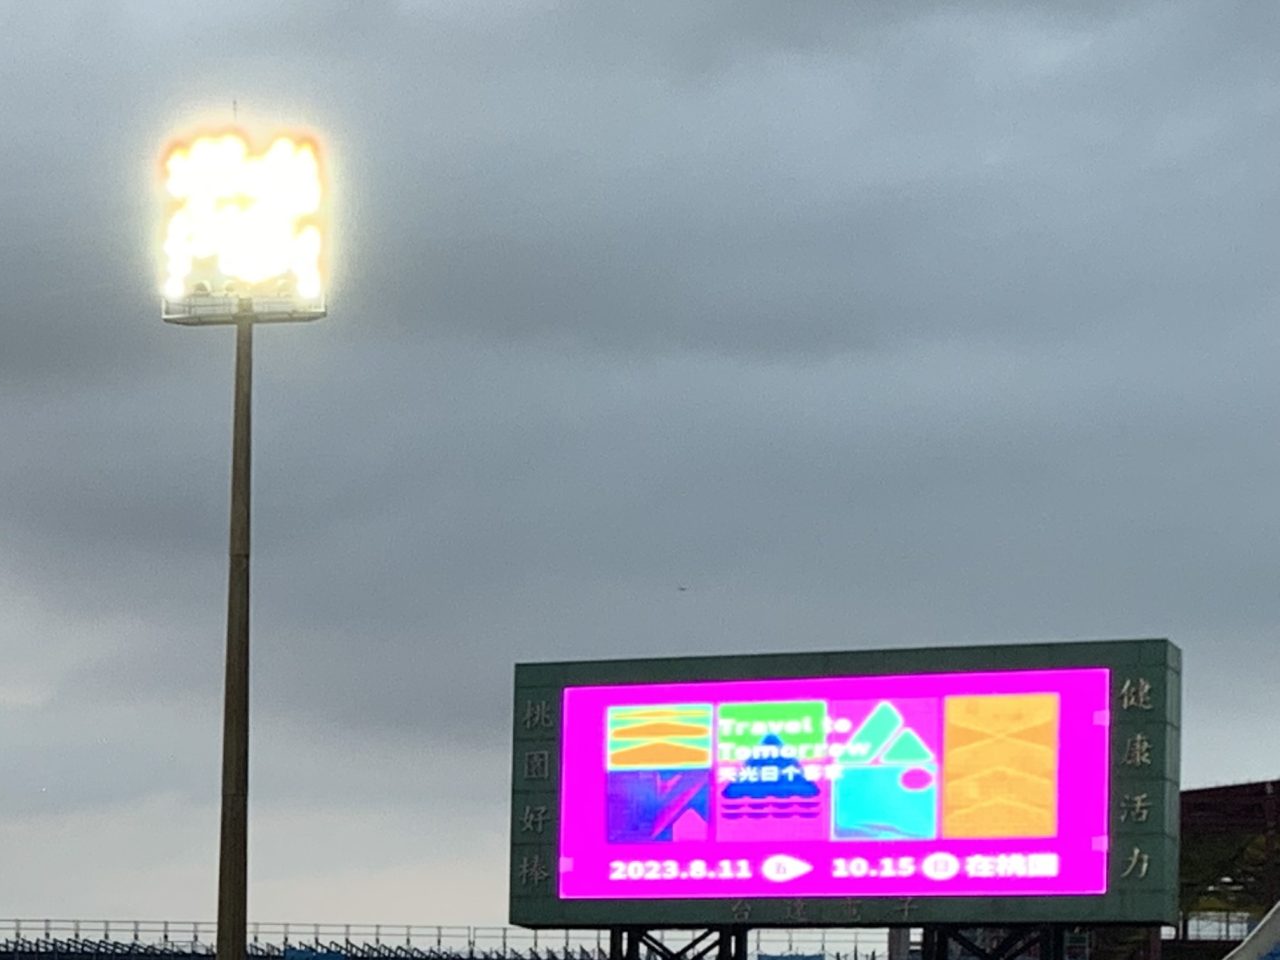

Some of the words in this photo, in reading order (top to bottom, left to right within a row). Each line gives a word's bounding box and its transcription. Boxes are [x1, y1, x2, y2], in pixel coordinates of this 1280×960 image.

[719, 716, 813, 736] Travel
[718, 743, 871, 762] Tomorrow
[1120, 678, 1154, 878] 健康活力
[520, 701, 553, 886] 桃園好棒
[609, 859, 753, 880] 2023.8.11
[832, 857, 916, 878] 10.15
